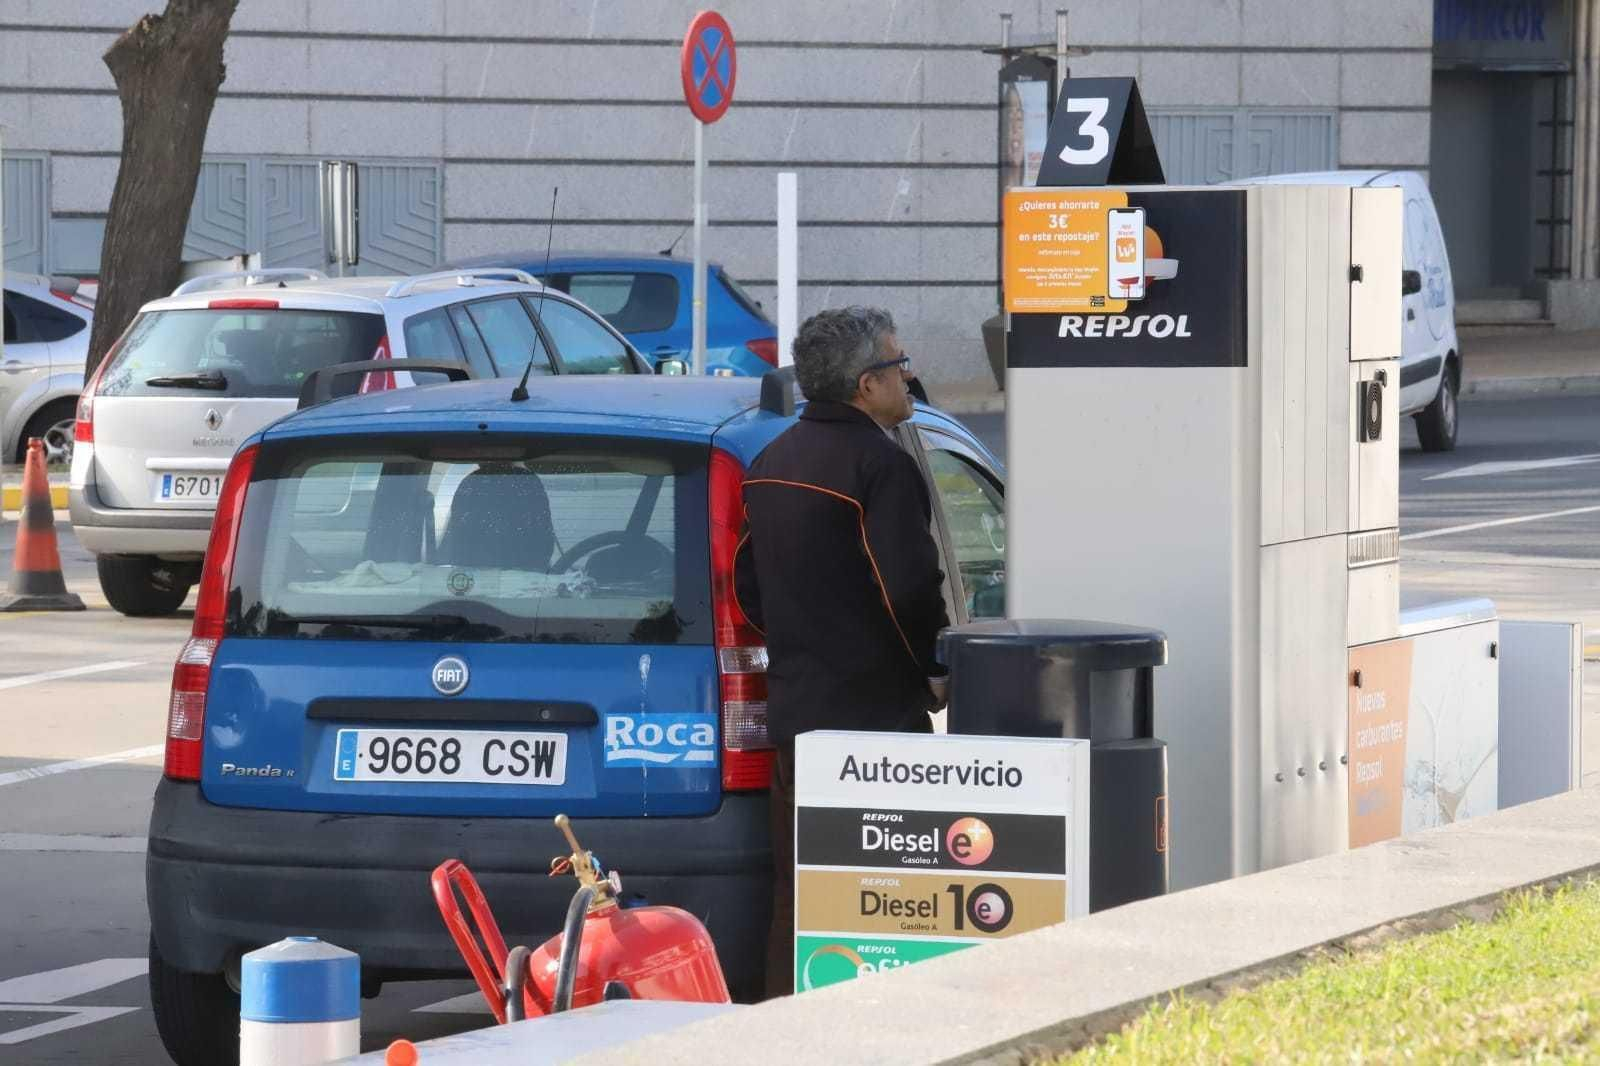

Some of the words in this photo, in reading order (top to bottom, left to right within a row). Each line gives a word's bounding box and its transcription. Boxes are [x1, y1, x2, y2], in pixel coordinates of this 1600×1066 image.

[1059, 97, 1110, 165] 3
[1018, 200, 1057, 213] ¿Quieres
[1059, 199, 1100, 210] ahorrarte
[1018, 234, 1030, 242] en
[1032, 232, 1052, 242] este
[1053, 232, 1100, 244] repostaje?
[1058, 314, 1192, 338] REPSOL
[437, 669, 462, 682] FIAT
[606, 715, 715, 747] Roca
[368, 736, 462, 775] 9668
[482, 738, 556, 779] CSW
[220, 763, 282, 777] Panda
[839, 754, 1023, 788] Autoservicio
[862, 813, 904, 822] REPSOL
[861, 825, 939, 853] Diesel
[901, 856, 931, 865] Gasóleo
[931, 857, 939, 865] A
[859, 877, 902, 887] REPSOL
[860, 890, 938, 918] Diesel
[900, 922, 929, 931] Gasóleo
[930, 923, 938, 931] A
[856, 944, 897, 955] REPSOL
